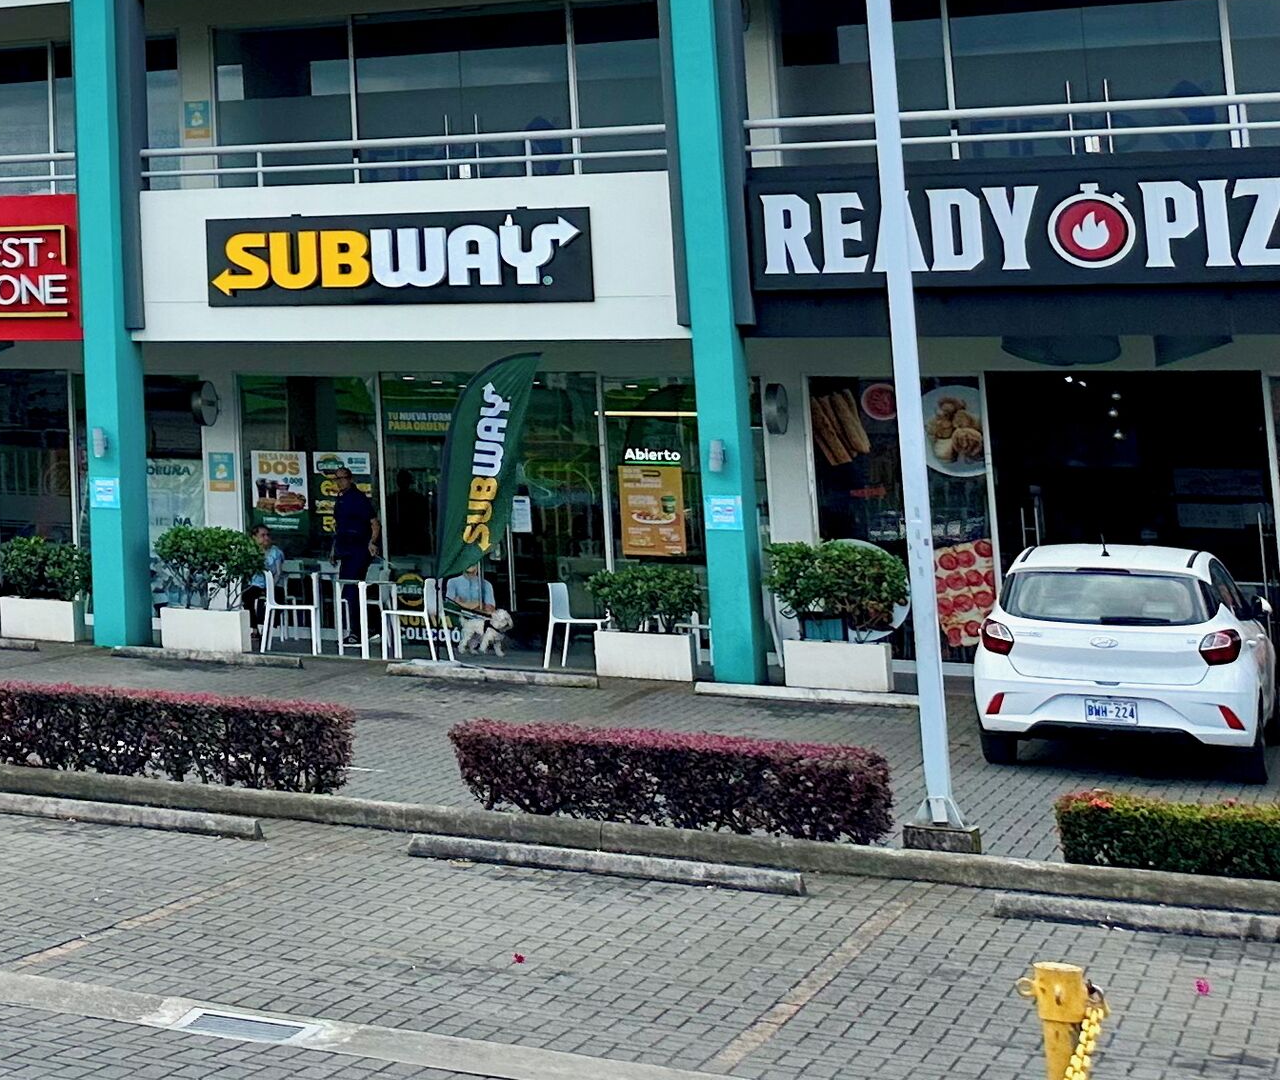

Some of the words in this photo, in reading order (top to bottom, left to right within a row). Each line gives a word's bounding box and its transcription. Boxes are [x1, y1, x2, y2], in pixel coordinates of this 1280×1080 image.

[760, 185, 1039, 275] READY
[211, 215, 582, 296] SUBWAY
[259, 461, 300, 476] DOS
[463, 381, 511, 552] SUBWAY
[624, 448, 681, 461] Abierto
[1087, 705, 1135, 719] BWH-224
